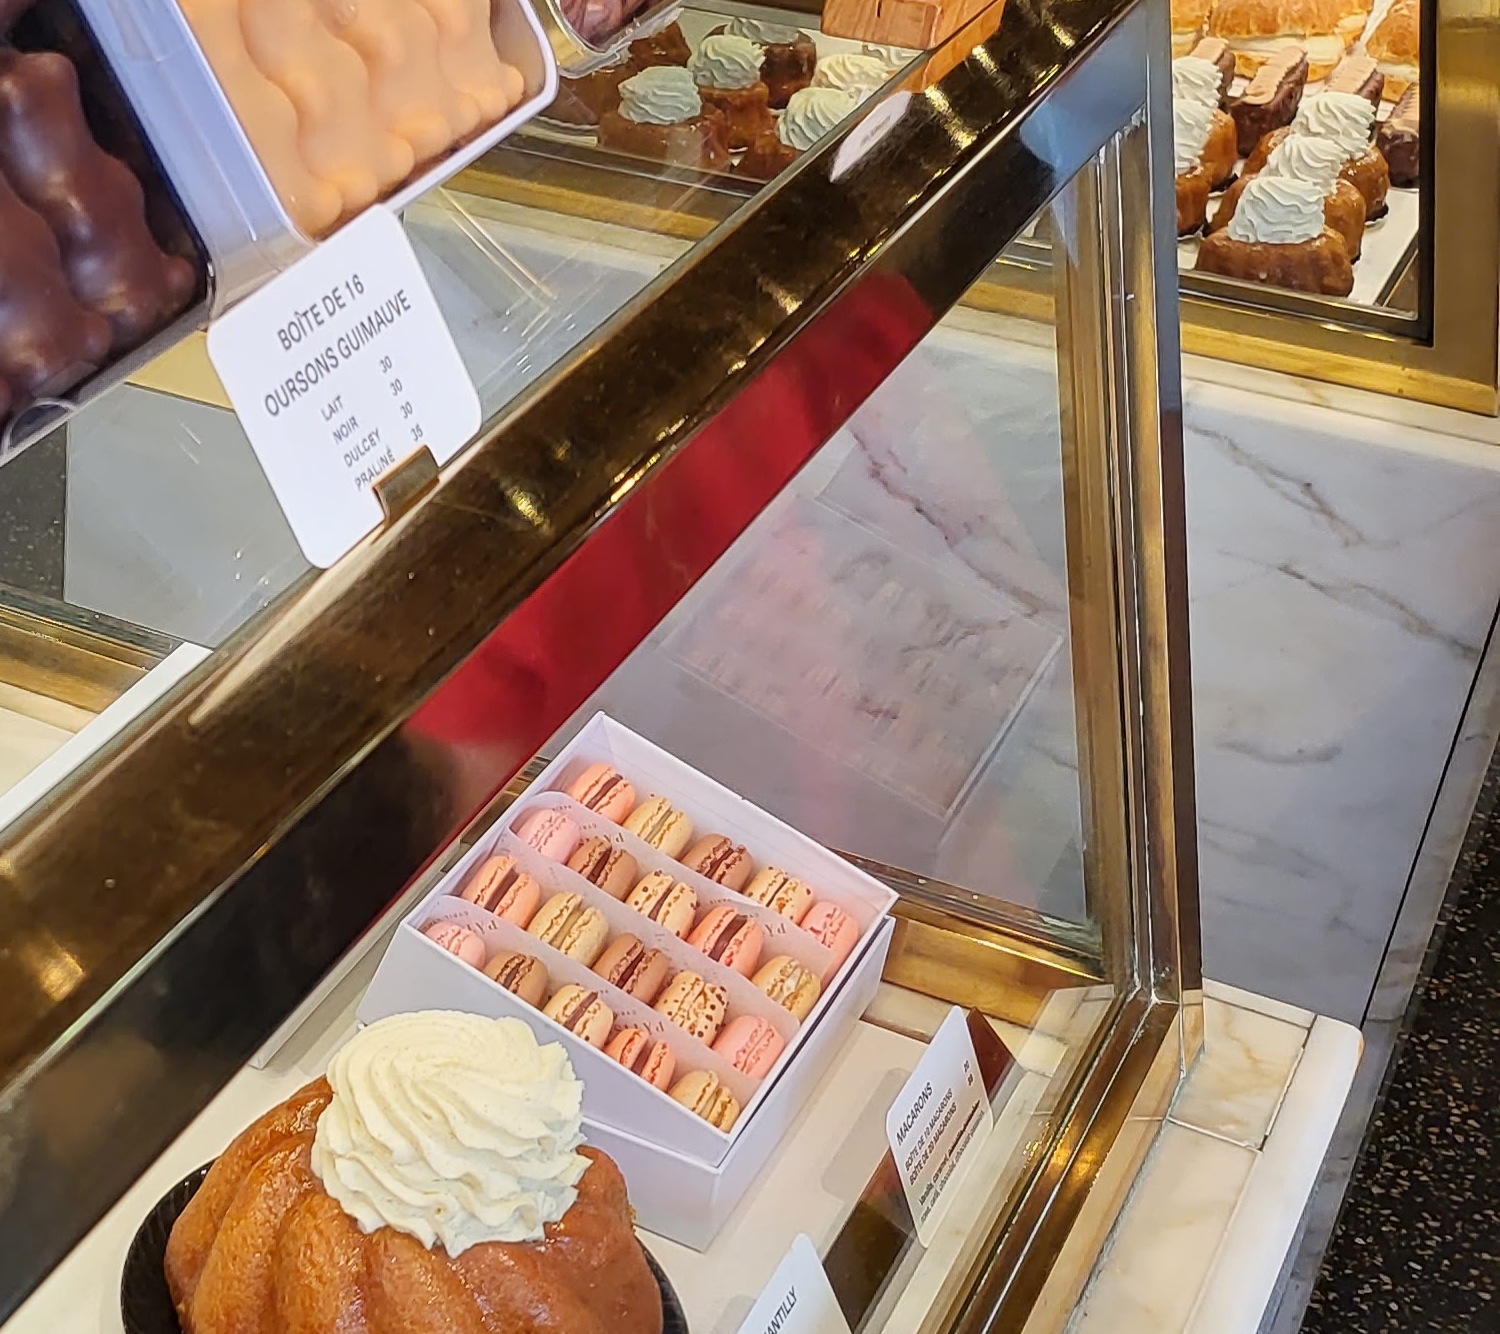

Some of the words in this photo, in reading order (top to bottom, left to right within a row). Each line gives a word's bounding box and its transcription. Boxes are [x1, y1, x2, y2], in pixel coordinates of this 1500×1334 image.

[277, 303, 325, 352] BOÎTE
[321, 286, 347, 318] DE
[344, 273, 365, 300] 16
[264, 346, 339, 417] OURSONS
[337, 288, 412, 360] GUIMAUVE
[321, 394, 343, 422] LAIT
[379, 355, 393, 374] 30
[332, 415, 359, 443] NOIR
[389, 378, 403, 397] 30
[343, 427, 381, 468] DULCEY
[400, 401, 413, 420] 30
[354, 446, 396, 491] PRALINÉ
[410, 423, 424, 442] 35
[896, 1081, 933, 1146] MACARONS
[904, 1145, 919, 1172] BOÎTE
[917, 1135, 926, 1151] DE
[928, 1087, 953, 1132] MACARONS
[909, 1159, 924, 1186] BOÎTE
[921, 1149, 930, 1166] DE
[932, 1101, 957, 1146] MACARONS
